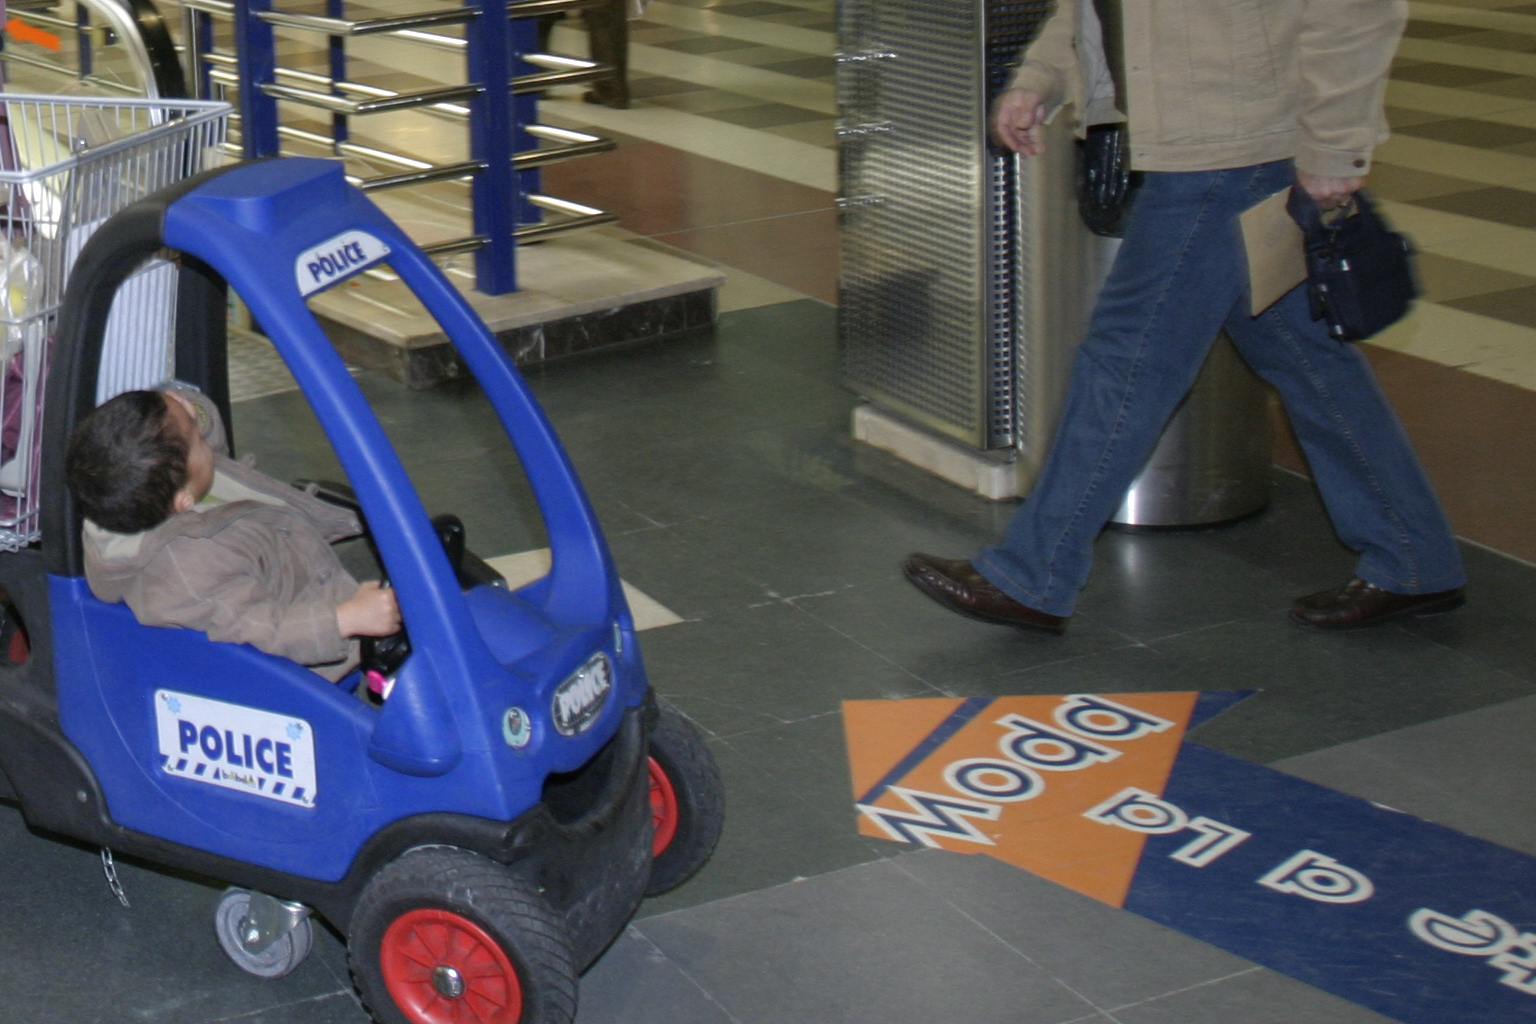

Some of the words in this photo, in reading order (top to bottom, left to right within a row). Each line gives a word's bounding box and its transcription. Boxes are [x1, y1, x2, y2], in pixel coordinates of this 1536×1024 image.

[307, 241, 367, 283] POLICE
[555, 659, 610, 726] POLICE
[178, 719, 294, 779] POLICE
[855, 694, 1175, 849] Moda
[1082, 786, 1252, 869] La
